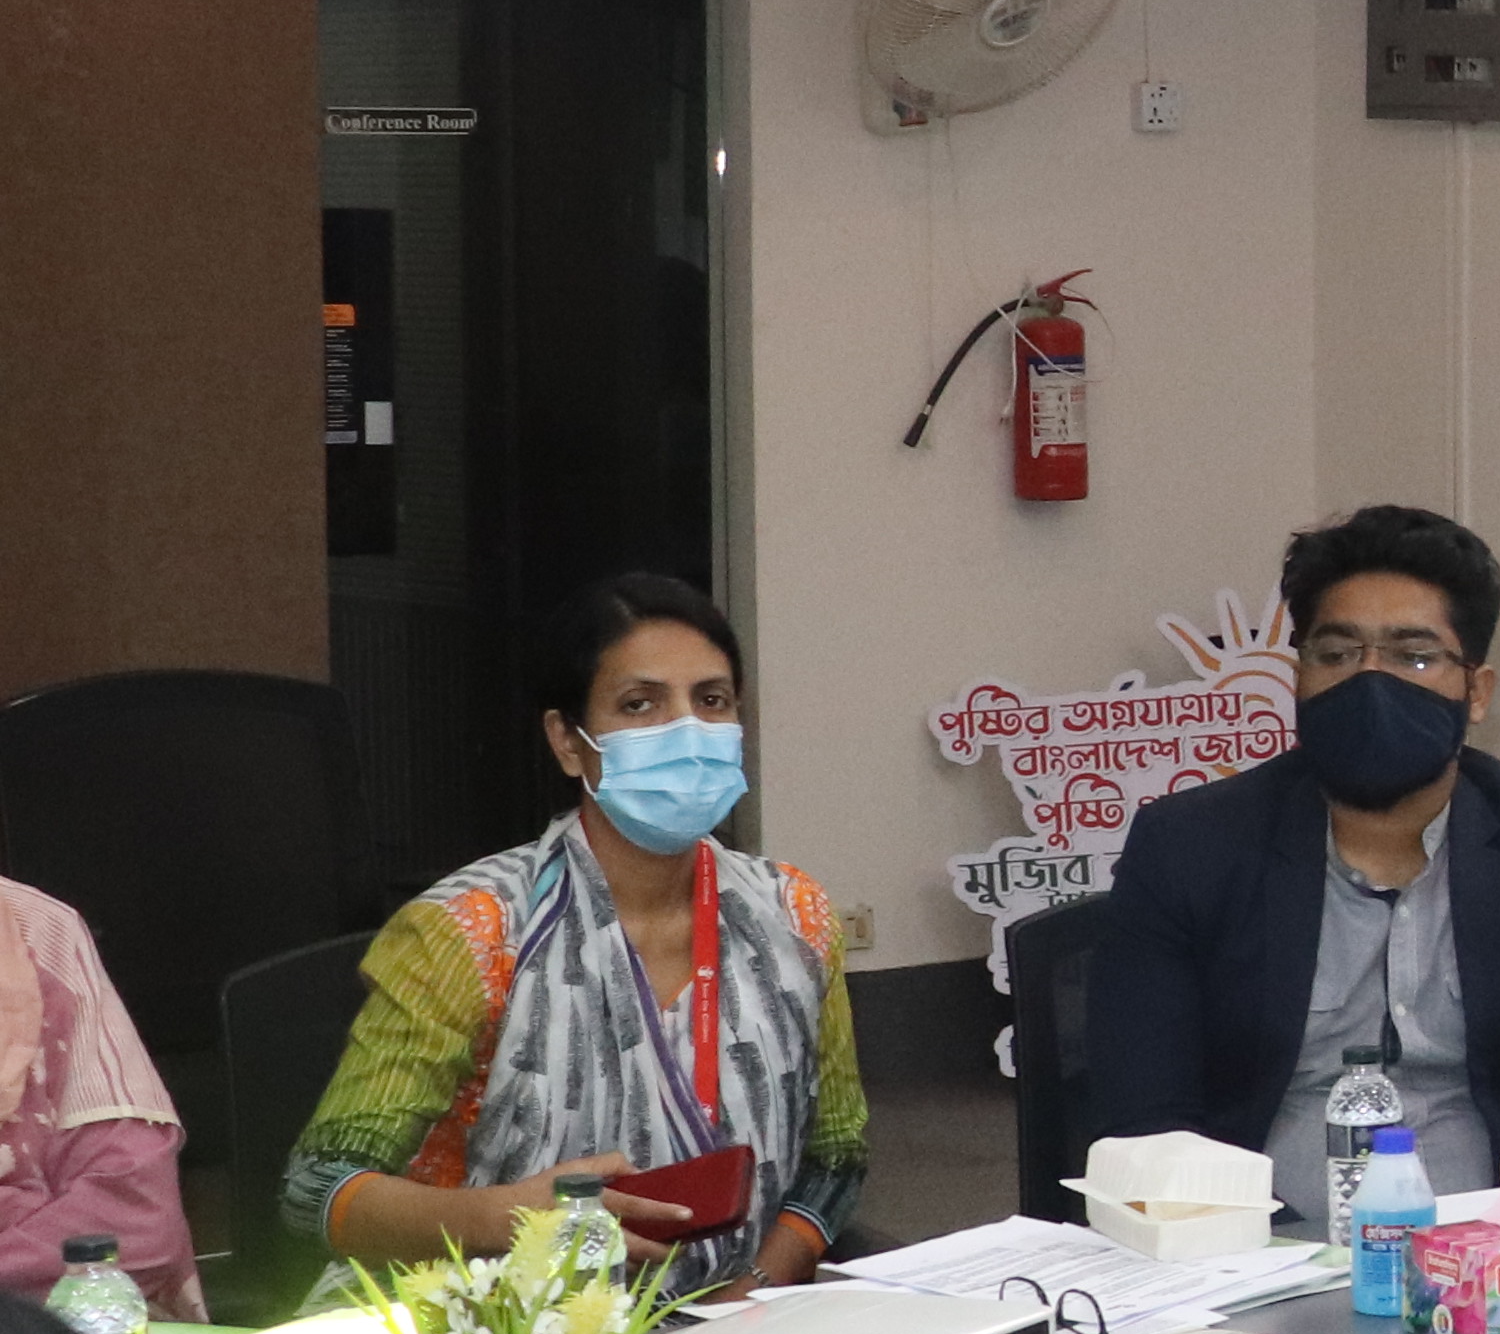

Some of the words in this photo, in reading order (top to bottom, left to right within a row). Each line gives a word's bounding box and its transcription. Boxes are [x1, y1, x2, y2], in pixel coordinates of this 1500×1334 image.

[327, 114, 422, 130] Conference
[426, 114, 475, 130] Room
[939, 685, 1051, 755] পুষ্টির
[1061, 691, 1243, 733] অগ্রযাত্রায়
[1011, 735, 1181, 777] বাংলাদেশ
[1034, 772, 1126, 851] পুষ্টি
[957, 846, 1095, 909] মুজিব
